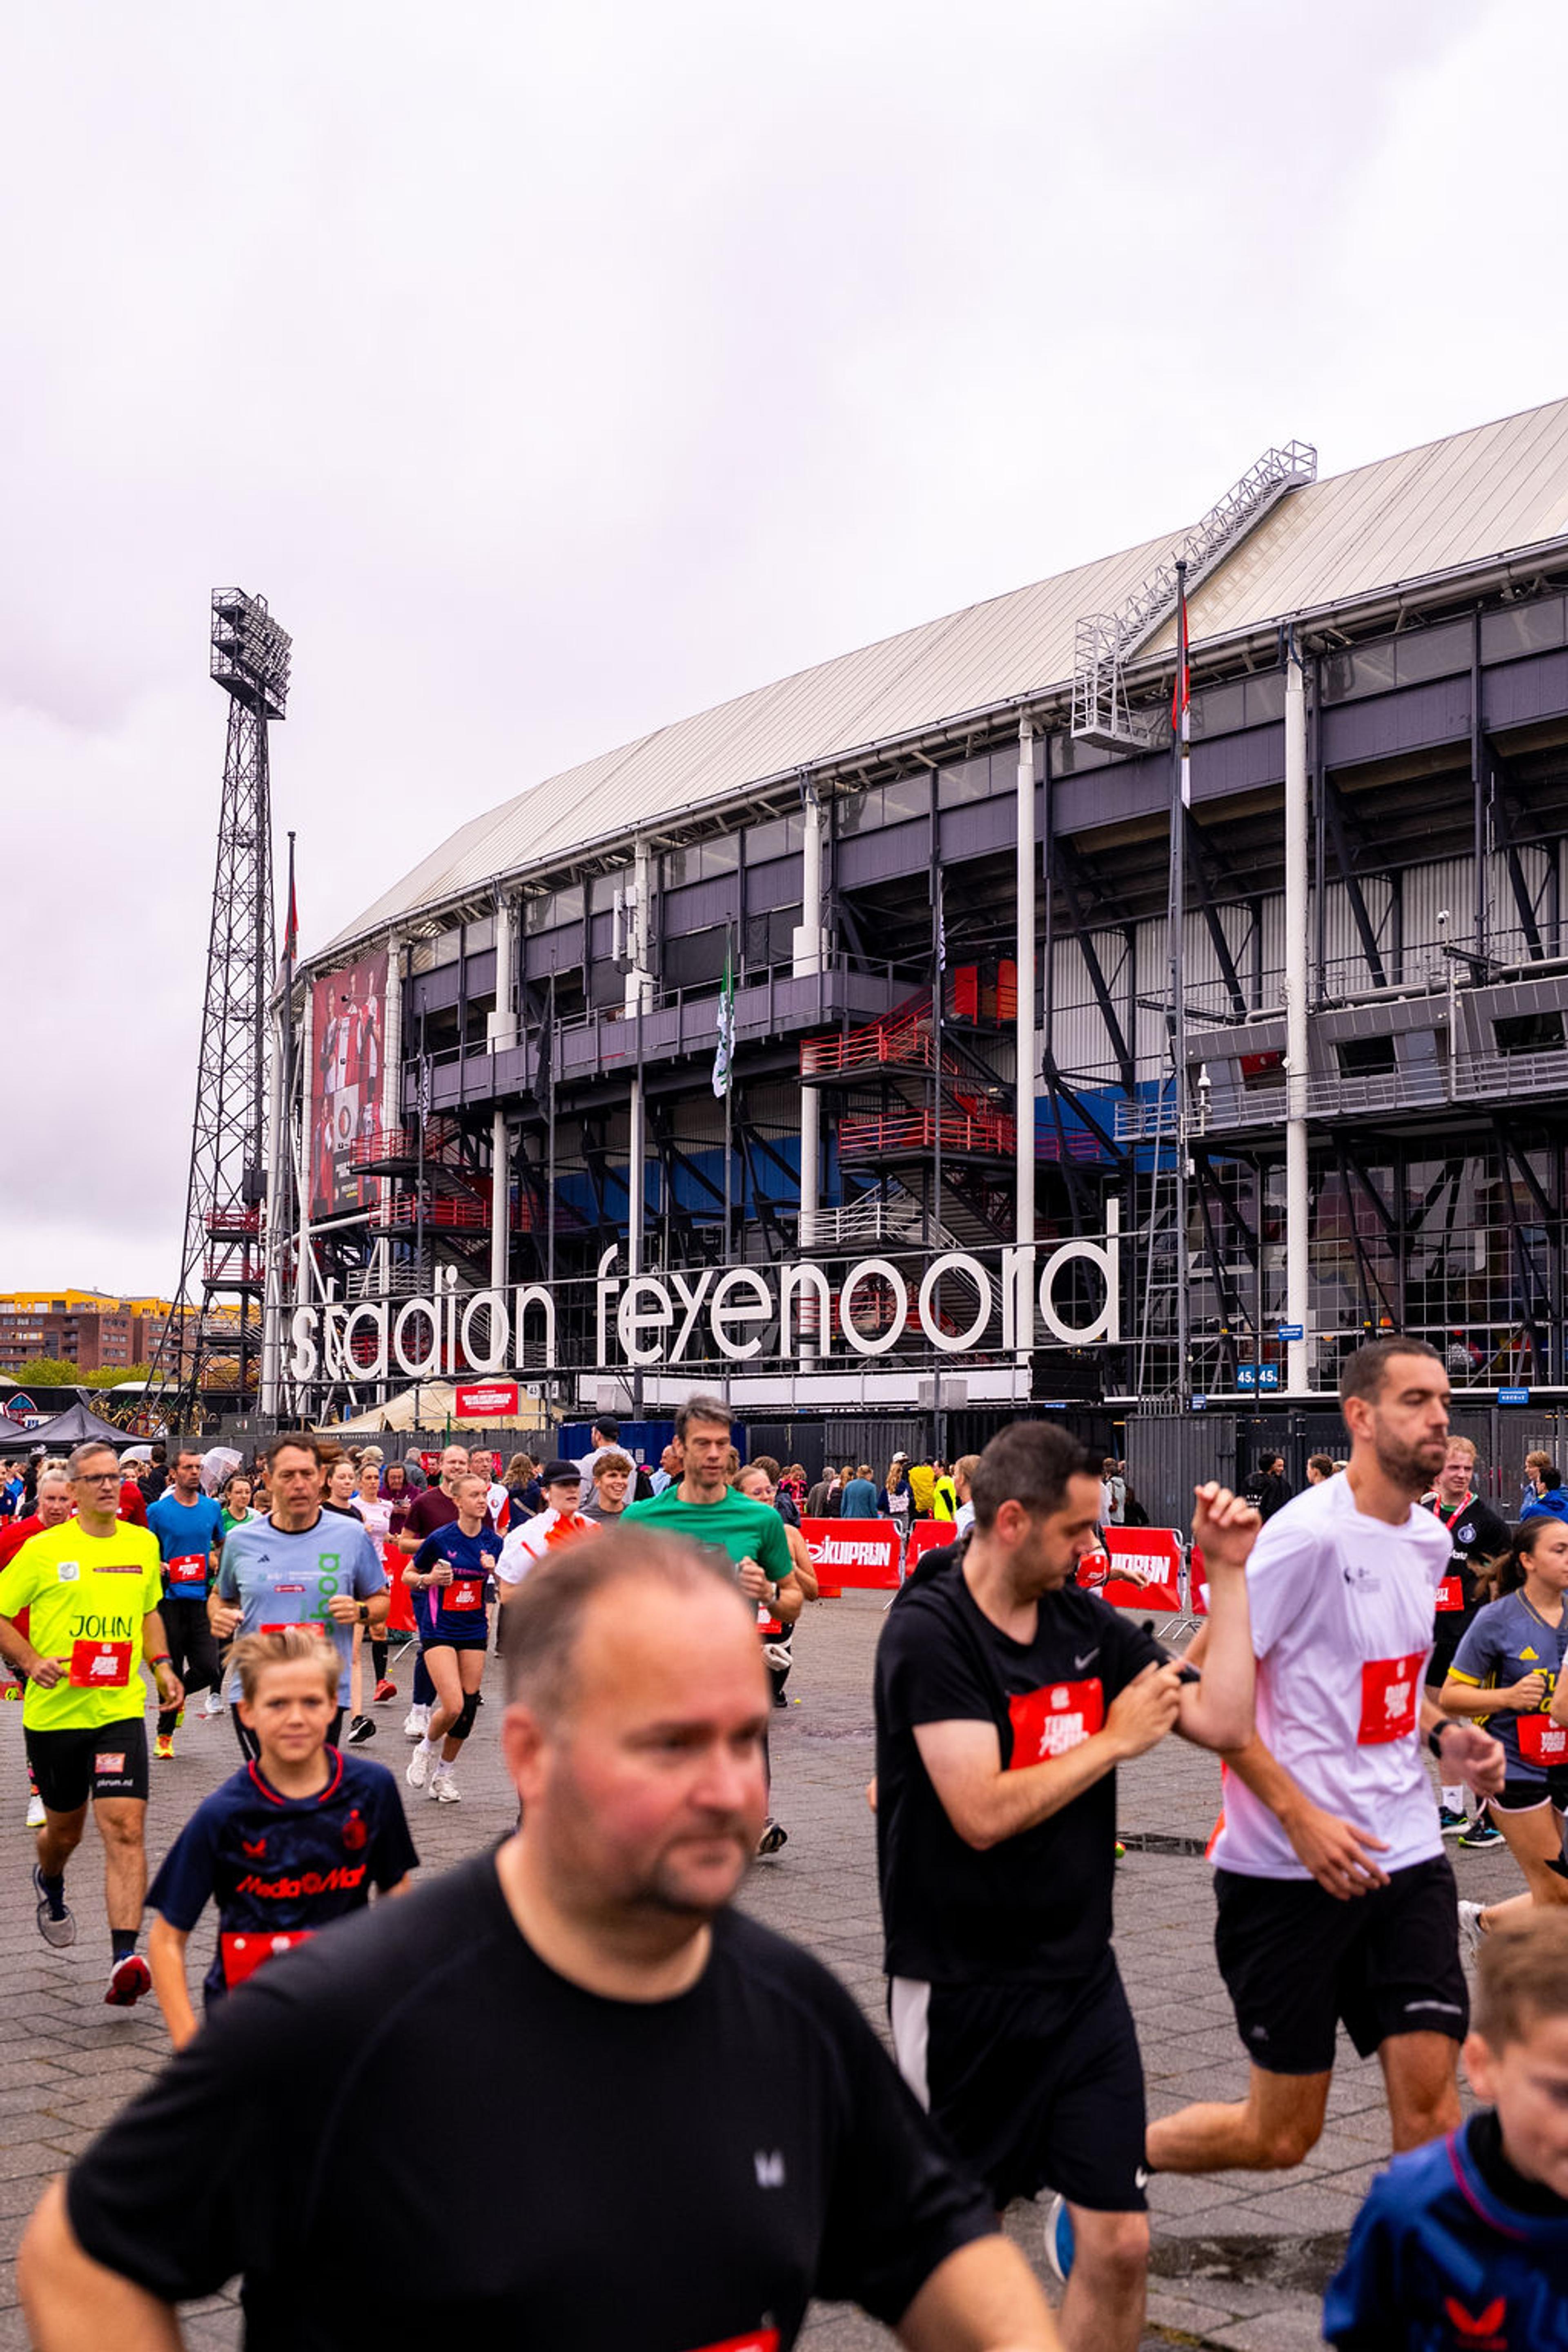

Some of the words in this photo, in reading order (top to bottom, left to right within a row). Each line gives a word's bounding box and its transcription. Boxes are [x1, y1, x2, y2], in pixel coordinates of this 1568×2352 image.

[291, 1264, 555, 1383] stadion
[597, 1198, 1120, 1366] feyenoord
[69, 1615, 133, 1638] JOHN
